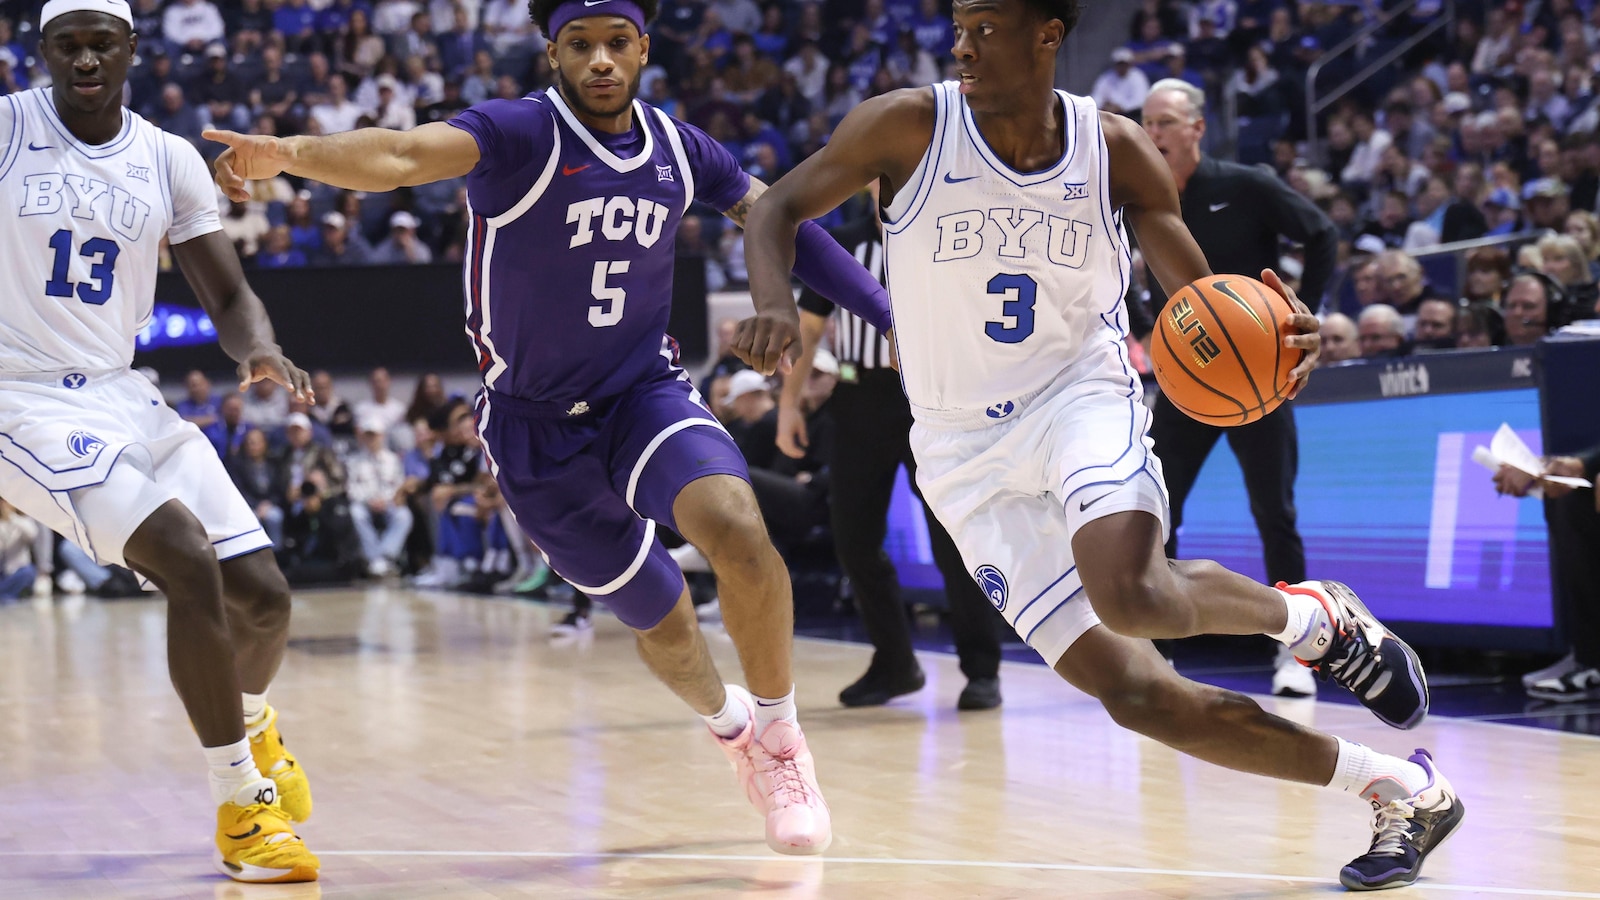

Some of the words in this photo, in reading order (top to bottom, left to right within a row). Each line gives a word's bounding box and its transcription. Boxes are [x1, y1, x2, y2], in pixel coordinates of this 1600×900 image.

[19, 172, 151, 242] BYU
[565, 196, 670, 249] TCU
[933, 208, 1093, 269] BYU
[45, 229, 120, 305] 13
[588, 260, 630, 328] 5
[984, 272, 1038, 343] 3
[1170, 296, 1222, 366] ELITE
